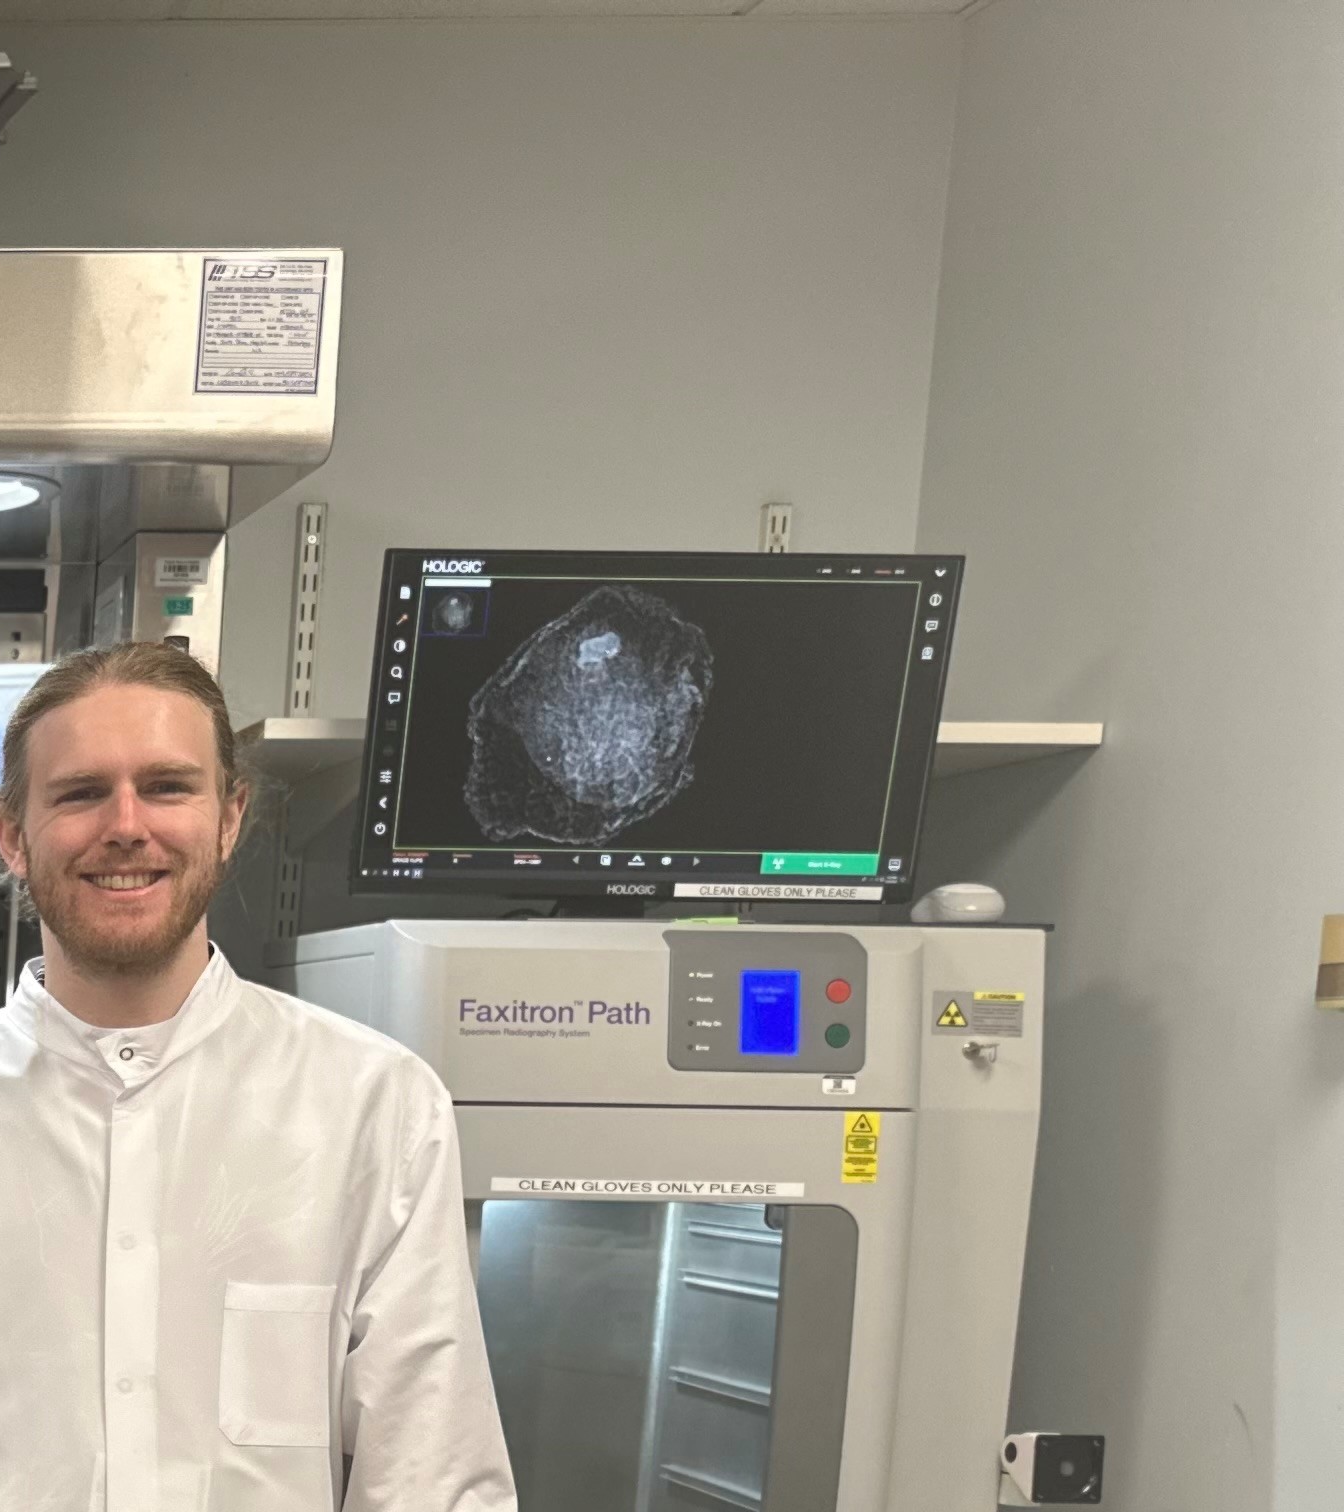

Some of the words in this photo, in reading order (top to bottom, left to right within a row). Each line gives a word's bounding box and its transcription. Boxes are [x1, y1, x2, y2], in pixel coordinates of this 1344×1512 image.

[422, 559, 483, 573] HOLOGIC
[607, 884, 656, 895] HOLOGIC
[699, 885, 735, 897] CLEAN
[737, 886, 781, 897] GLOVES
[783, 887, 813, 898] ONLY
[814, 887, 857, 898] PLEASE
[588, 1000, 651, 1025] Path
[459, 1028, 502, 1036] Specimen
[503, 1028, 556, 1038] Radiography
[559, 1029, 591, 1038] System
[519, 1179, 576, 1191] CLEAN
[581, 1180, 652, 1193] GLOVES
[657, 1182, 705, 1194] ONLY
[709, 1182, 777, 1195] PLEASE
